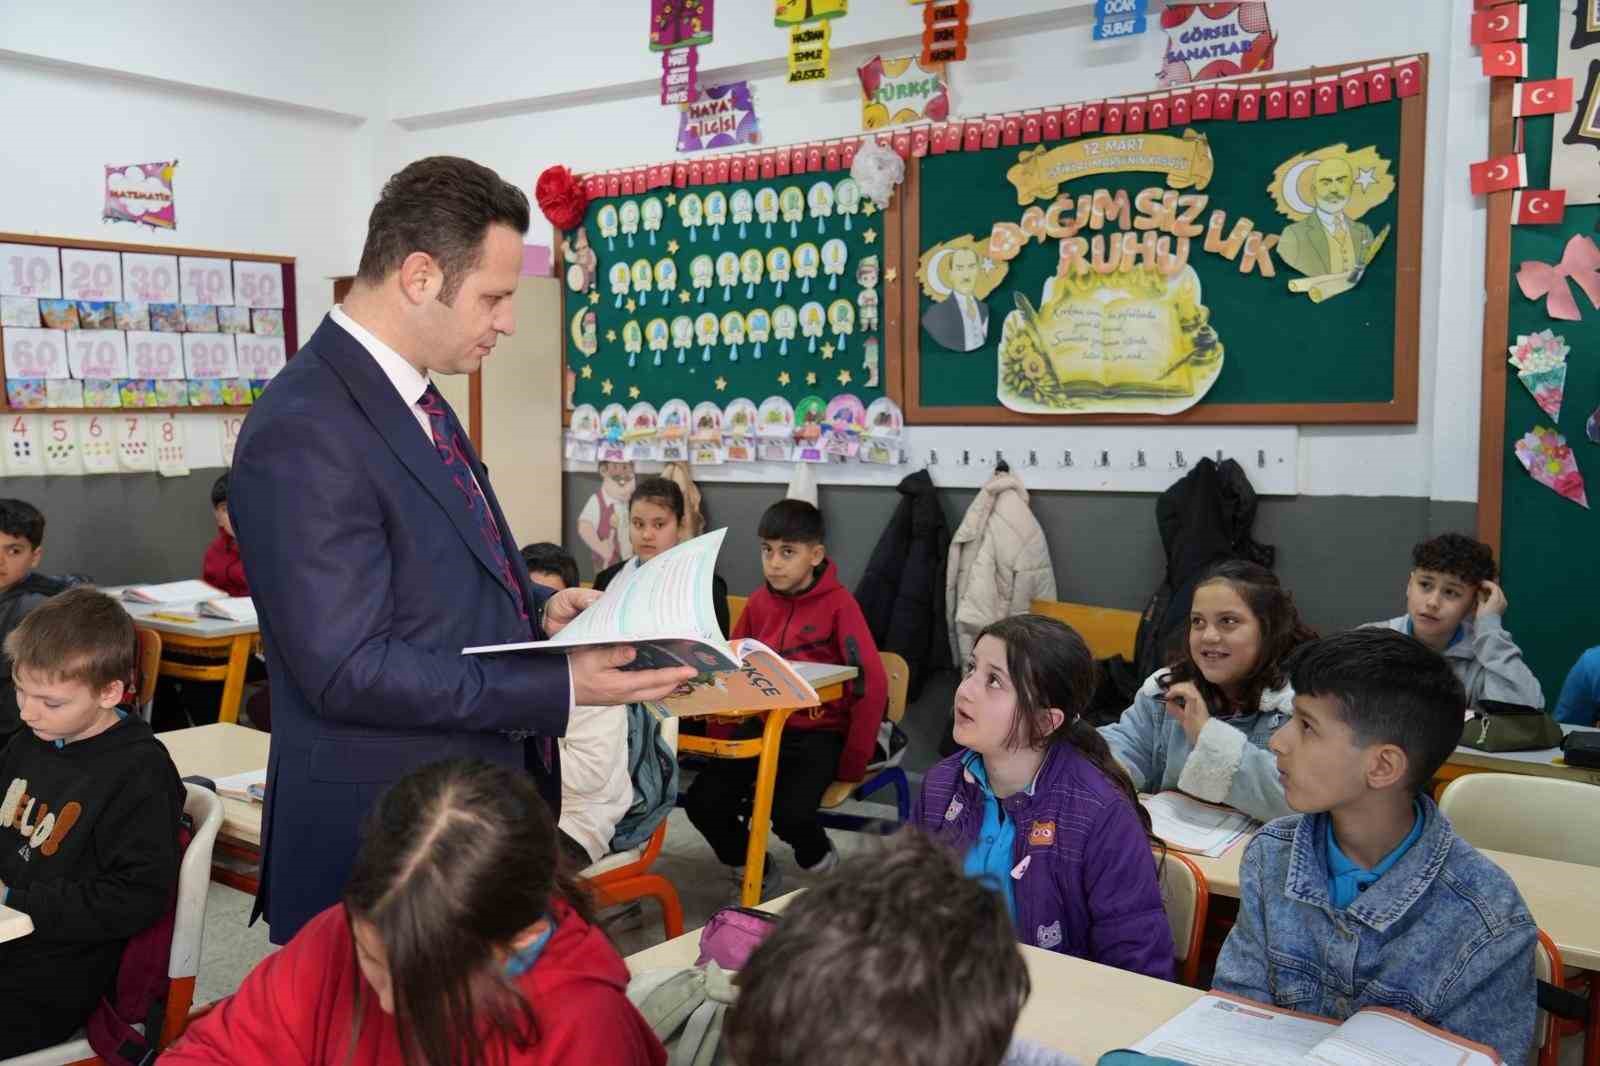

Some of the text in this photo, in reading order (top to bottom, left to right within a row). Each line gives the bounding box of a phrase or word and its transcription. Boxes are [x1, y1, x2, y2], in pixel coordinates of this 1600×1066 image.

[1179, 22, 1239, 45] GÖRSEL
[1167, 39, 1253, 64] SANATLAR
[689, 95, 737, 119] HAYAT
[1083, 137, 1145, 155] 12 MART
[1057, 231, 1190, 278] RUHU
[8, 255, 49, 289] 10
[69, 261, 113, 290] 20
[128, 266, 171, 292] 30
[239, 272, 276, 298] 50
[12, 340, 58, 369] 60
[76, 341, 118, 369] 70
[135, 341, 175, 369] 80
[191, 342, 230, 369] 90
[239, 343, 281, 367] 100
[12, 416, 27, 437] 4
[52, 420, 67, 442] 5
[89, 416, 103, 437] 6
[124, 418, 139, 438] 7
[162, 422, 174, 442] 8
